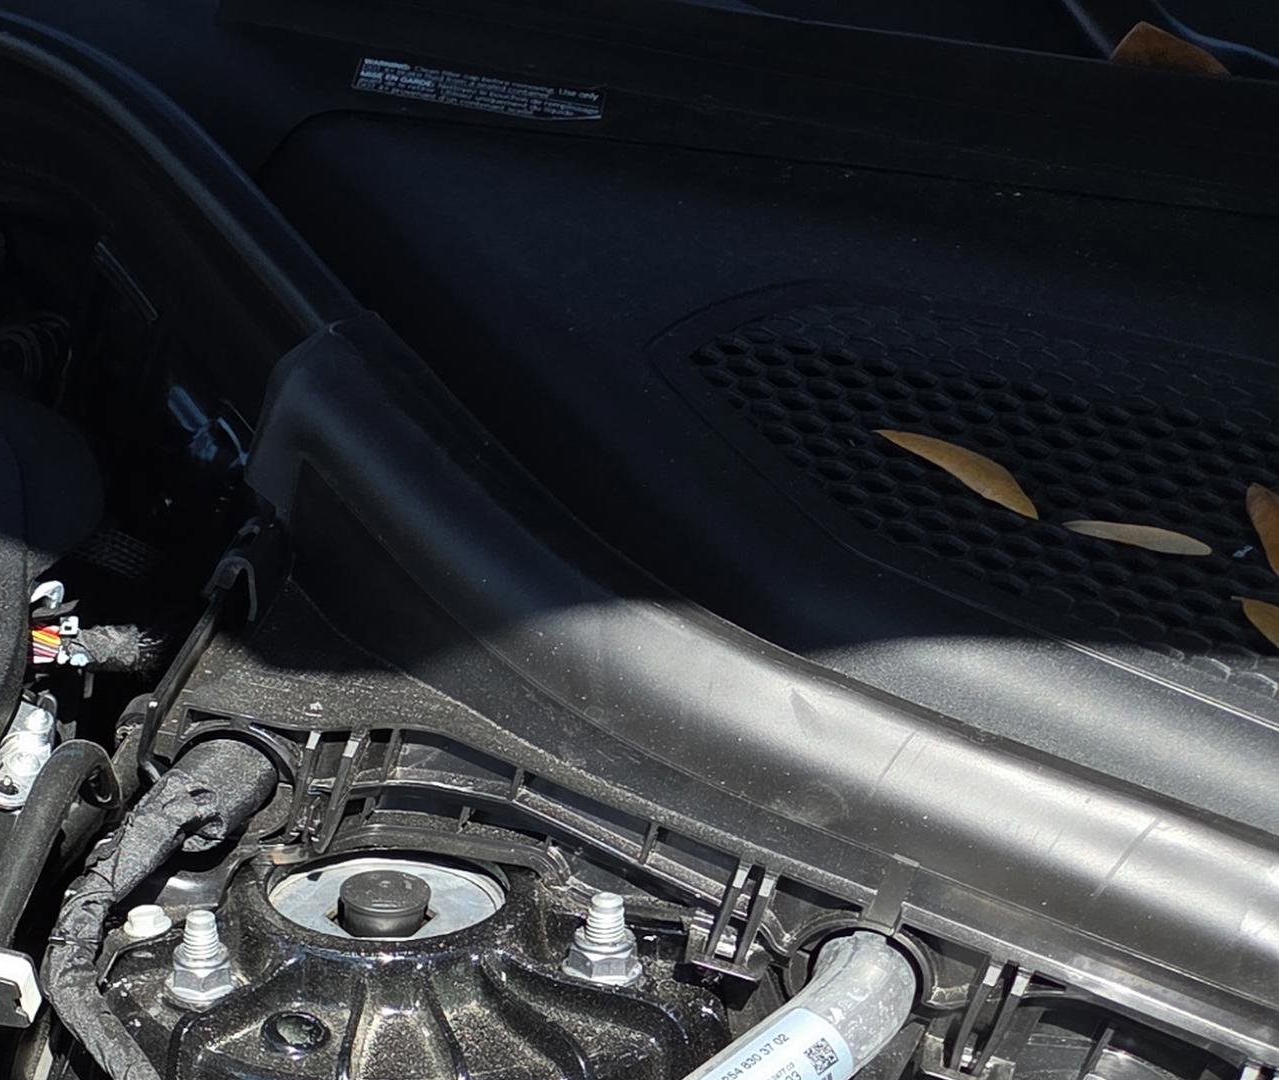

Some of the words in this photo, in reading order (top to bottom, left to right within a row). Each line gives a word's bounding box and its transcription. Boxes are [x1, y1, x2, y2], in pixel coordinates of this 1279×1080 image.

[578, 91, 599, 102] only
[740, 1052, 763, 1069] 830
[759, 1042, 775, 1056] 37
[772, 1033, 790, 1046] 02
